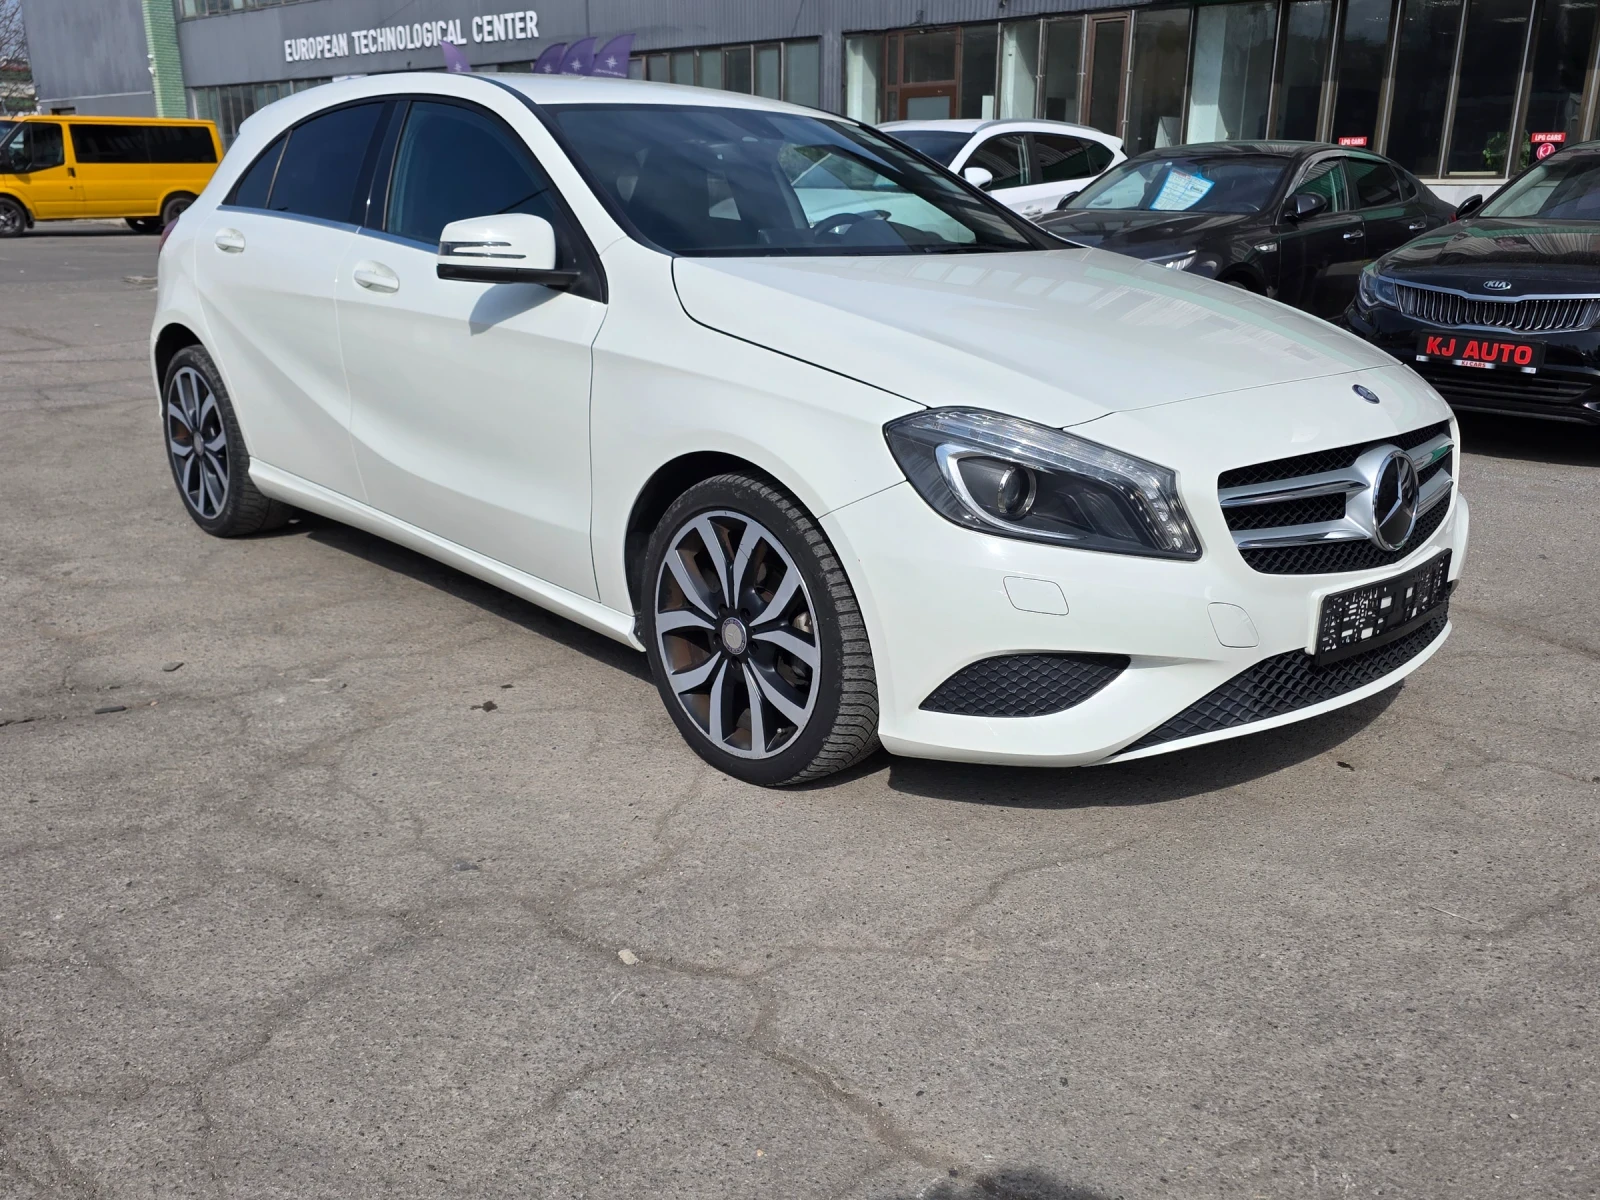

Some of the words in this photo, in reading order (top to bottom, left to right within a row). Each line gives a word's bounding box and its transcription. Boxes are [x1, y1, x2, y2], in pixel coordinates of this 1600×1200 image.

[284, 33, 348, 61] EUROPEAN
[351, 19, 467, 55] TECHNOLOGICAL
[472, 11, 539, 42] CENTER
[1487, 280, 1507, 288] KIA
[1426, 336, 1456, 356] KJ
[1463, 340, 1532, 365] AUTO
